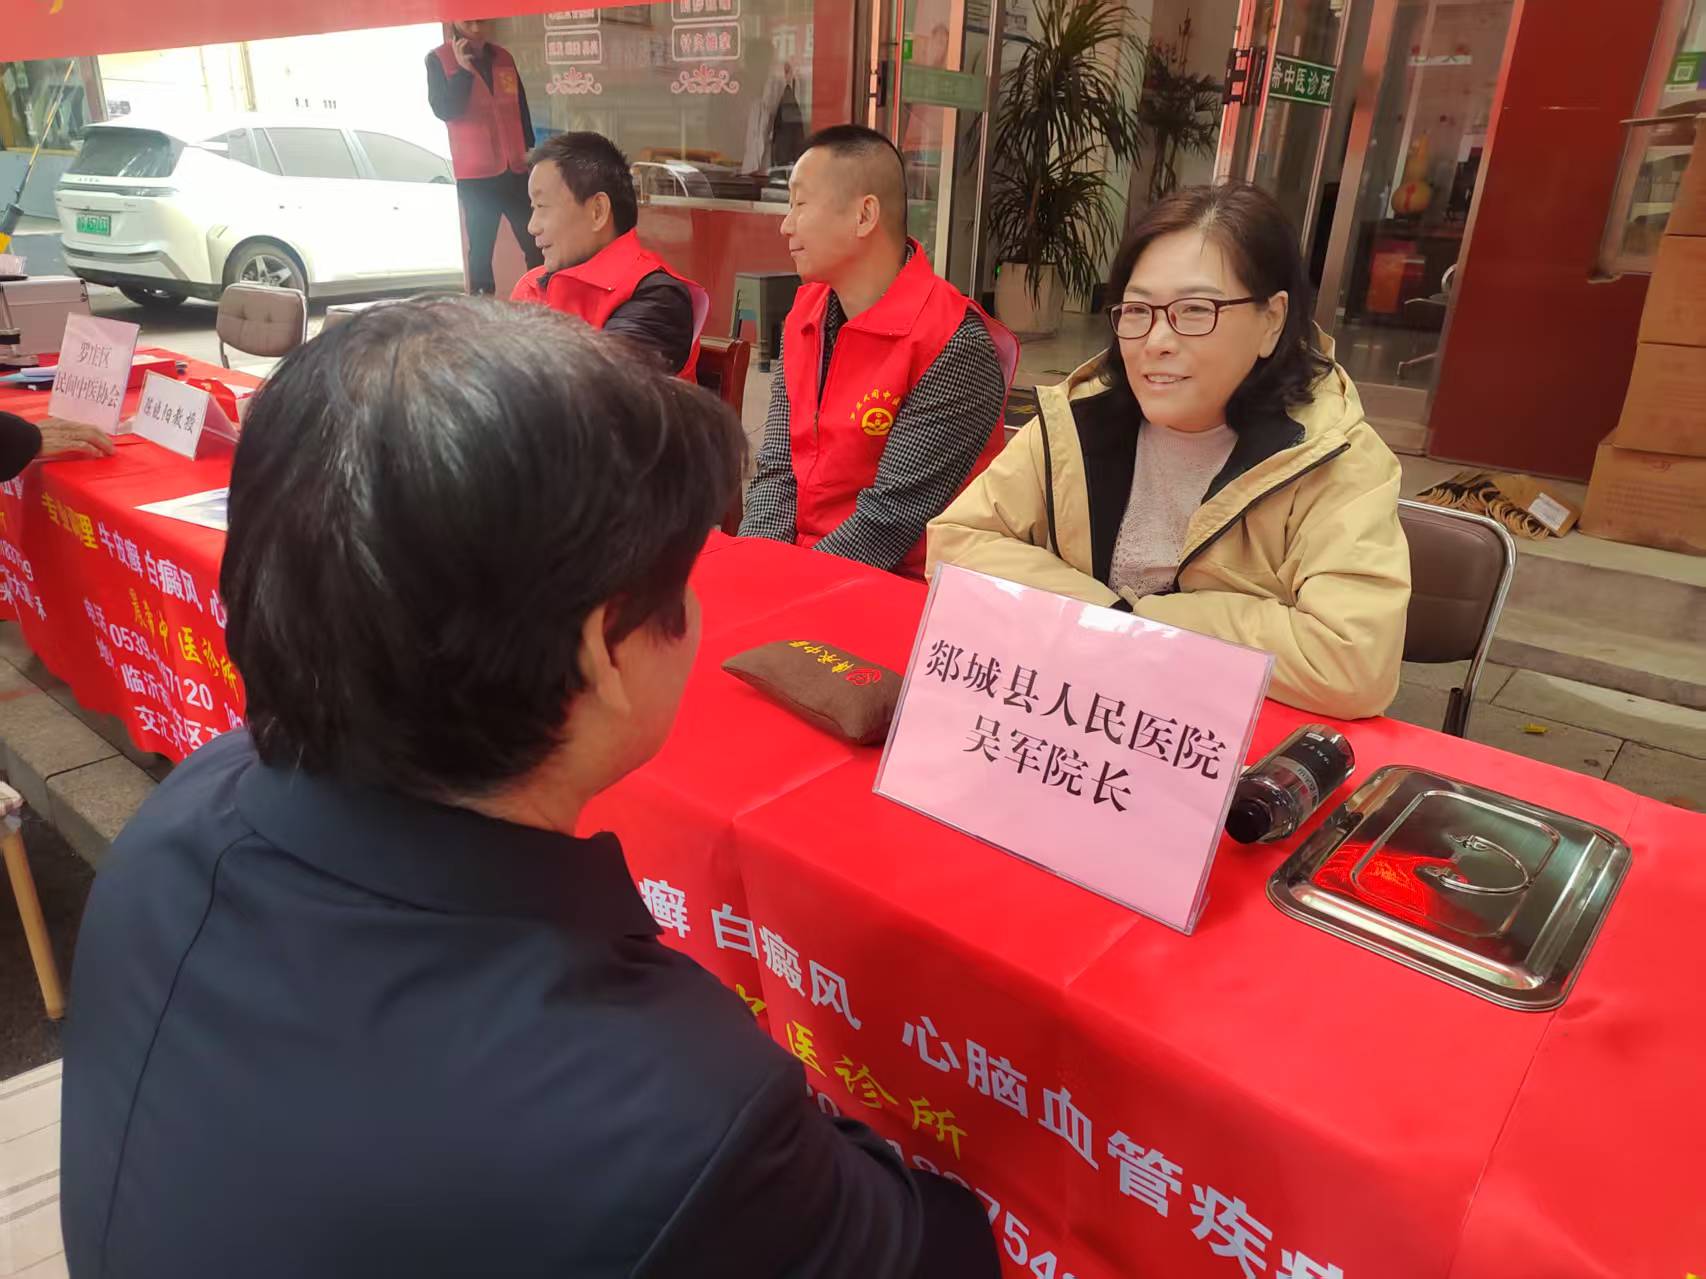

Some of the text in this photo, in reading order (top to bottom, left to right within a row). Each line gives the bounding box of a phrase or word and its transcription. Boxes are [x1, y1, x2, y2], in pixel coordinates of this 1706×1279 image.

[924, 639, 1227, 780] 郯城县人民医院
[962, 714, 1133, 813] 吴军院长
[711, 904, 862, 1030] 白癜风
